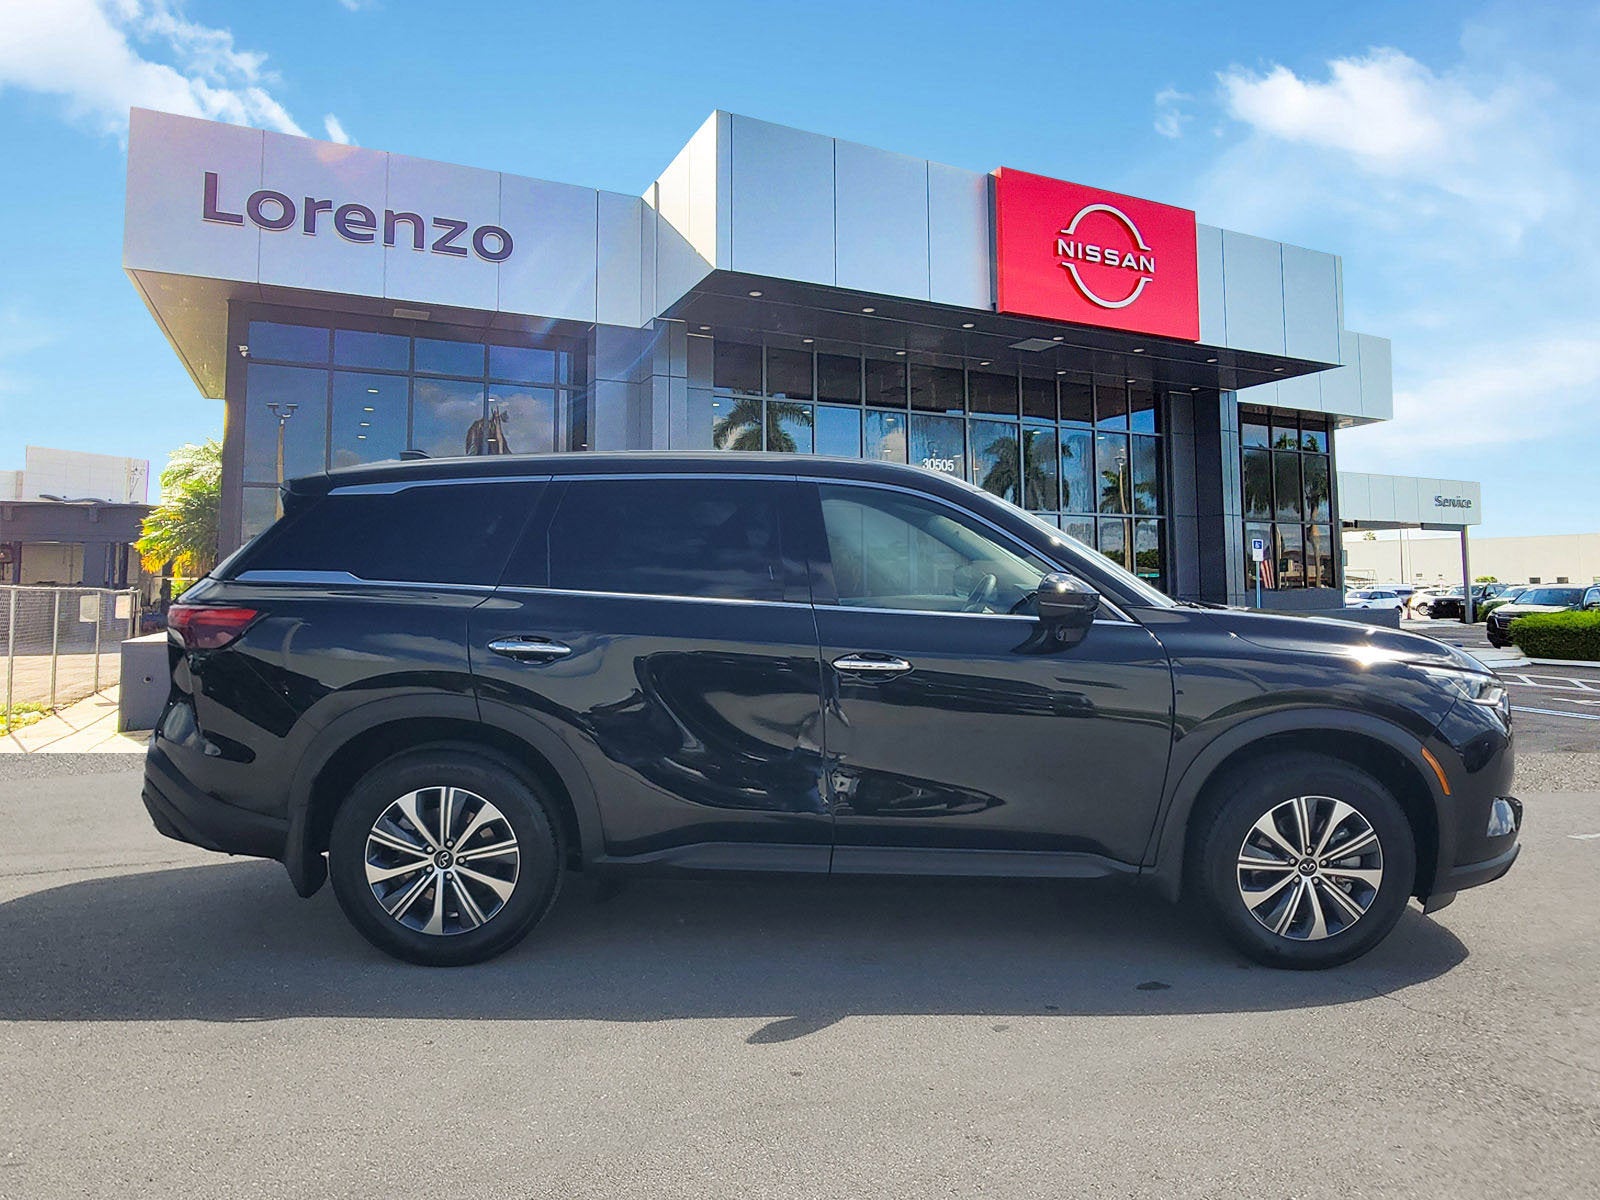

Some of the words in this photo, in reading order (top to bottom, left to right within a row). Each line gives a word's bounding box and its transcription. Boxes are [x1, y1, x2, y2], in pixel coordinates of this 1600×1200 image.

[202, 171, 514, 262] Lorenzo
[1057, 238, 1155, 273] NISSAN
[922, 457, 954, 471] 30505
[1434, 495, 1472, 508] Service
